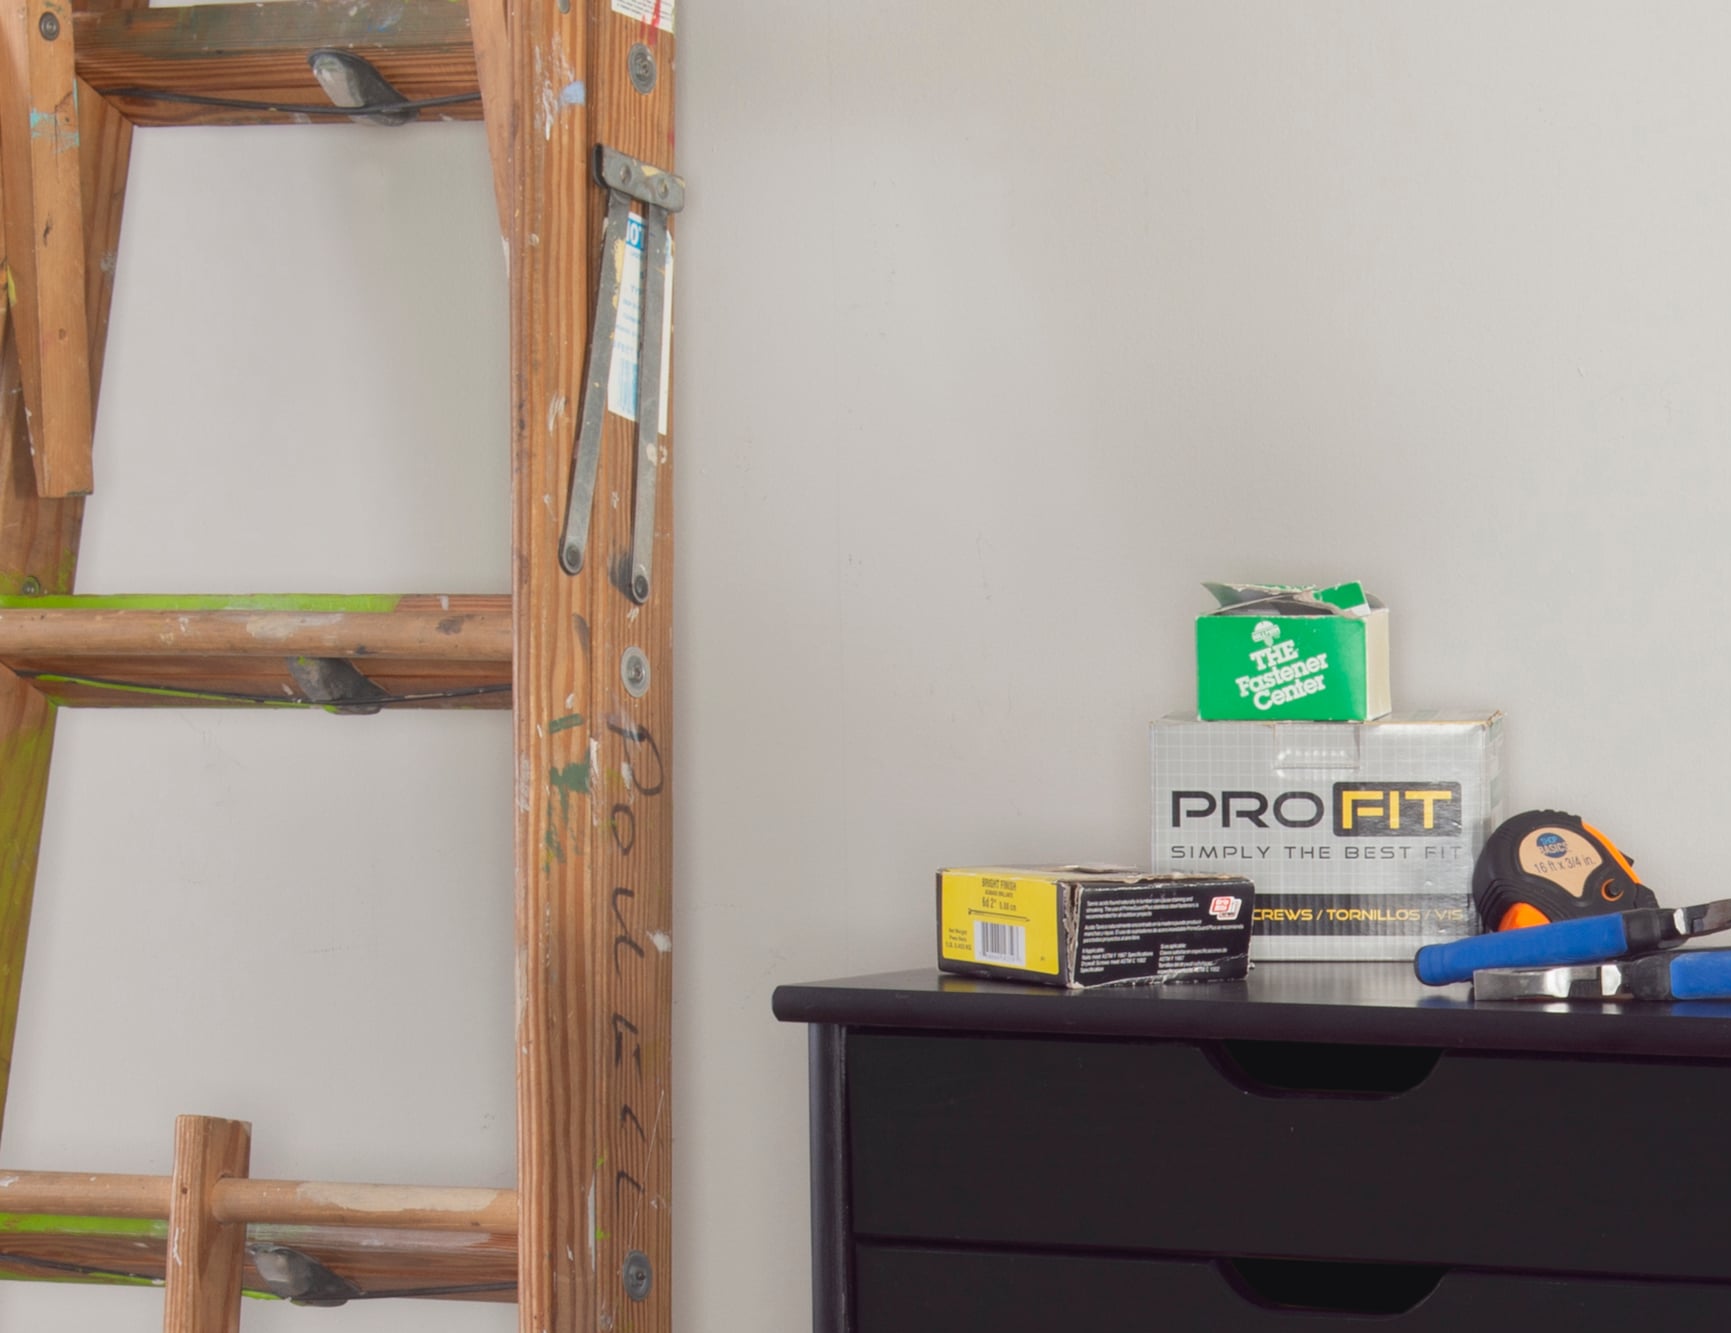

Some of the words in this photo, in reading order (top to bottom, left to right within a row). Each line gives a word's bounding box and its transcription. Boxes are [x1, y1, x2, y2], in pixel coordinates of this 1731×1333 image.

[1249, 640, 1299, 671] THE
[1235, 653, 1329, 697] Fastener
[1253, 674, 1326, 710] Center
[1171, 845, 1270, 859] SIMPLY
[1284, 845, 1331, 859] THE
[1345, 845, 1411, 859] BEST
[1425, 845, 1462, 859] FIT
[1566, 857, 1582, 869] 3/4
[1252, 909, 1313, 921] CREWS
[1326, 909, 1420, 921] TORNILLOS
[1435, 909, 1464, 920] VIS
